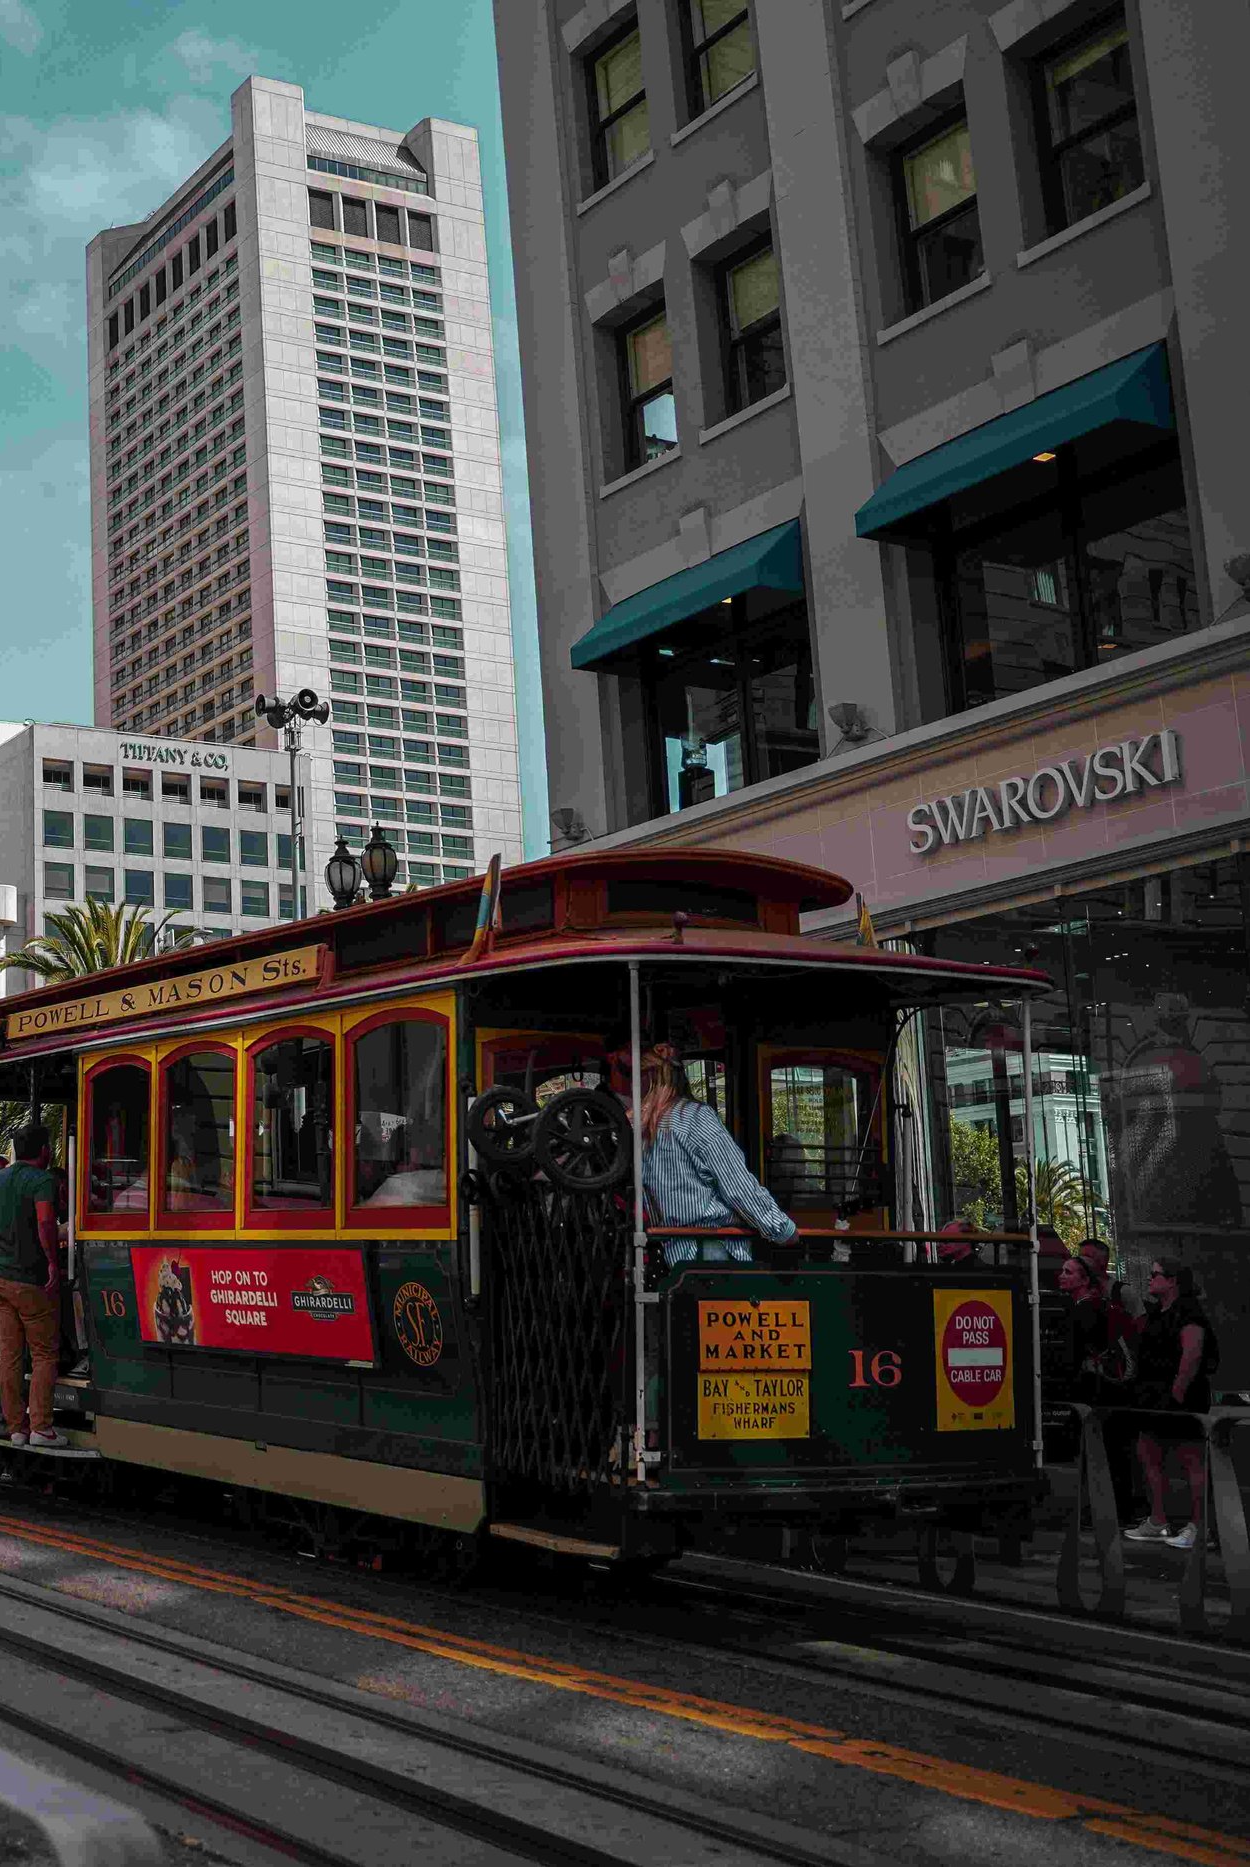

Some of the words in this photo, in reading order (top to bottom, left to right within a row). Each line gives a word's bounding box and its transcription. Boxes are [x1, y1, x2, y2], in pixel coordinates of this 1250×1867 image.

[120, 742, 188, 765] TIFFANY
[191, 751, 202, 767] &
[907, 728, 1182, 854] SWAROVSKI
[18, 999, 110, 1033] POWELL
[120, 993, 136, 1012] &
[147, 967, 249, 1007] MASON
[262, 958, 308, 983] Sts.
[211, 1270, 232, 1285] HOP
[235, 1271, 251, 1286] ON
[253, 1271, 268, 1286] TO
[101, 1290, 126, 1319] 16
[210, 1289, 278, 1308] GHIRARDELLI
[294, 1296, 352, 1310] GHIRARDELLI
[394, 1284, 438, 1317] MUNICIPAL
[225, 1309, 268, 1327] SQUARE
[706, 1312, 804, 1328] POWELL
[955, 1316, 971, 1329] DO
[973, 1316, 995, 1329] NOT
[733, 1329, 781, 1341] AND
[962, 1331, 990, 1345] PASS
[398, 1333, 442, 1364] RAILWAY
[705, 1343, 806, 1359] MARKET
[848, 1350, 902, 1388] 16
[950, 1369, 981, 1383] CABLE
[984, 1369, 1002, 1382] CAR
[703, 1379, 729, 1397] BAY
[755, 1379, 804, 1397] TAYLOR
[713, 1402, 796, 1416] FISHERMANS
[733, 1416, 776, 1429] WHARF
